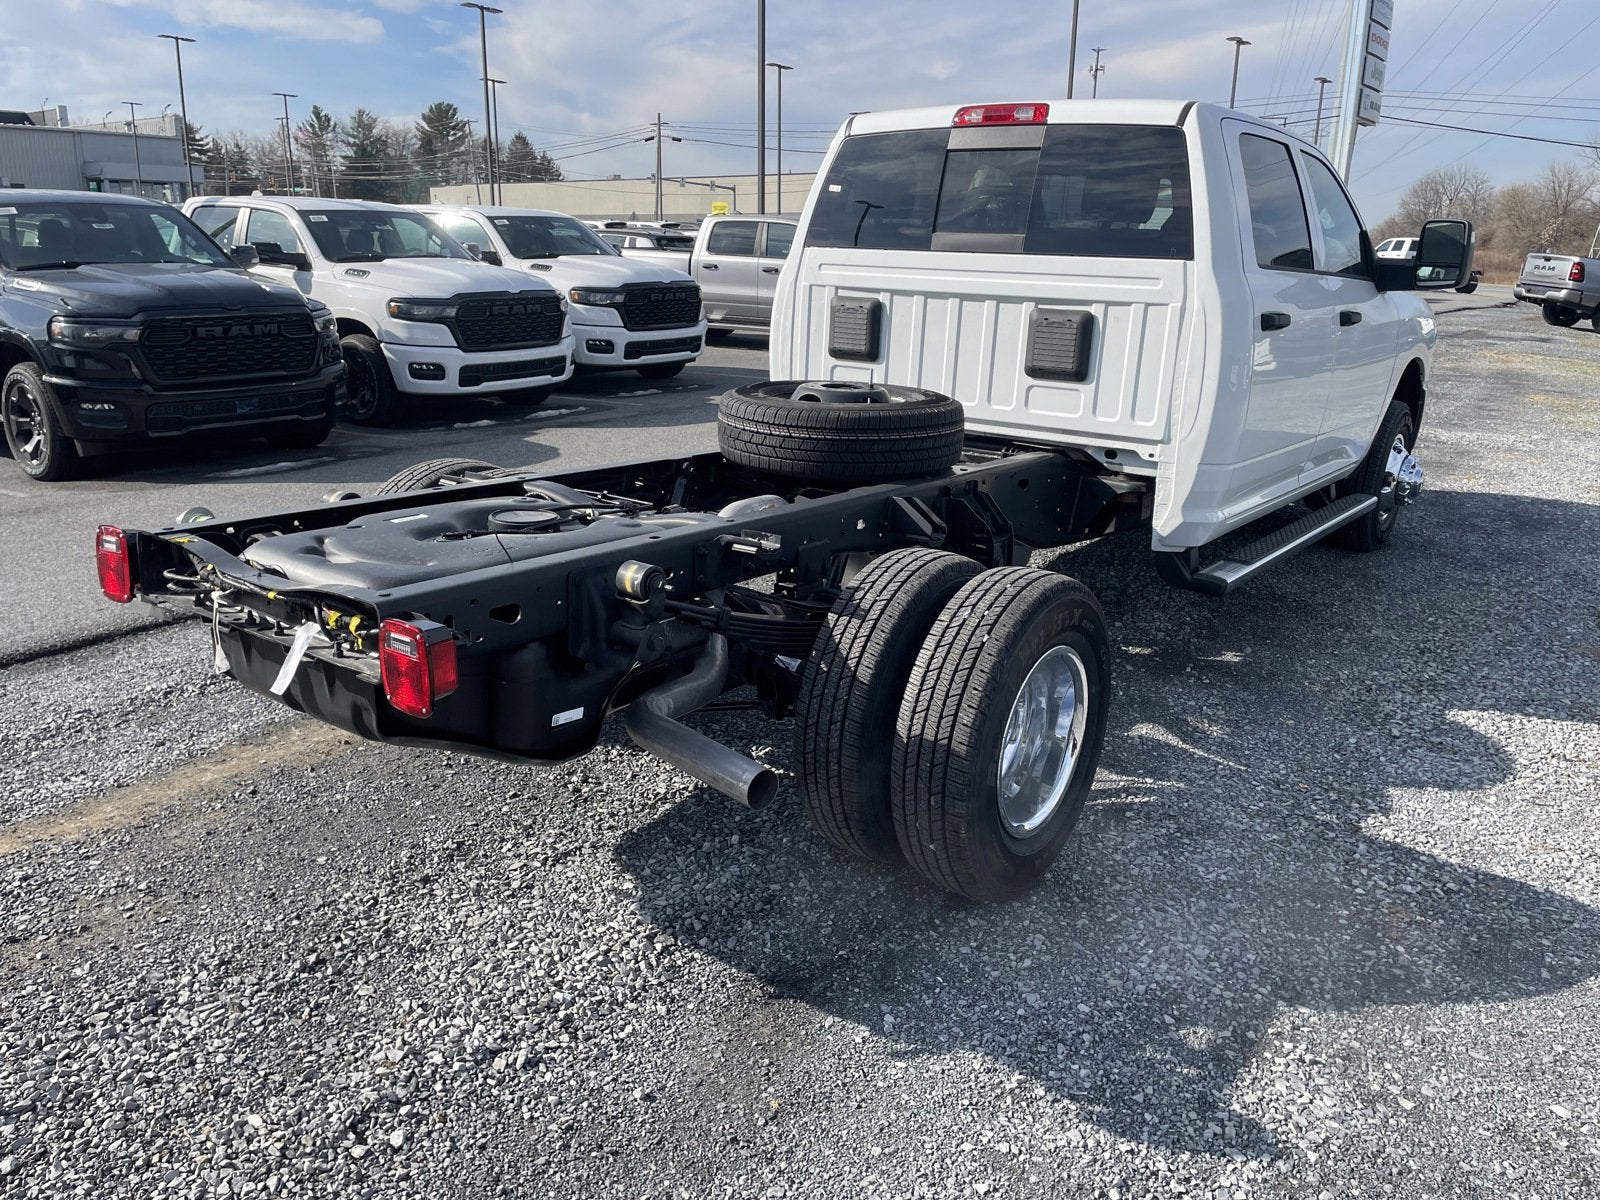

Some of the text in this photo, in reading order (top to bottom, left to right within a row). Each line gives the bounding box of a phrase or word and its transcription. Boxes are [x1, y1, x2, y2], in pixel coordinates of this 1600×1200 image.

[650, 293, 687, 301] RAM
[492, 304, 542, 315] RAM
[196, 323, 279, 338] RAM
